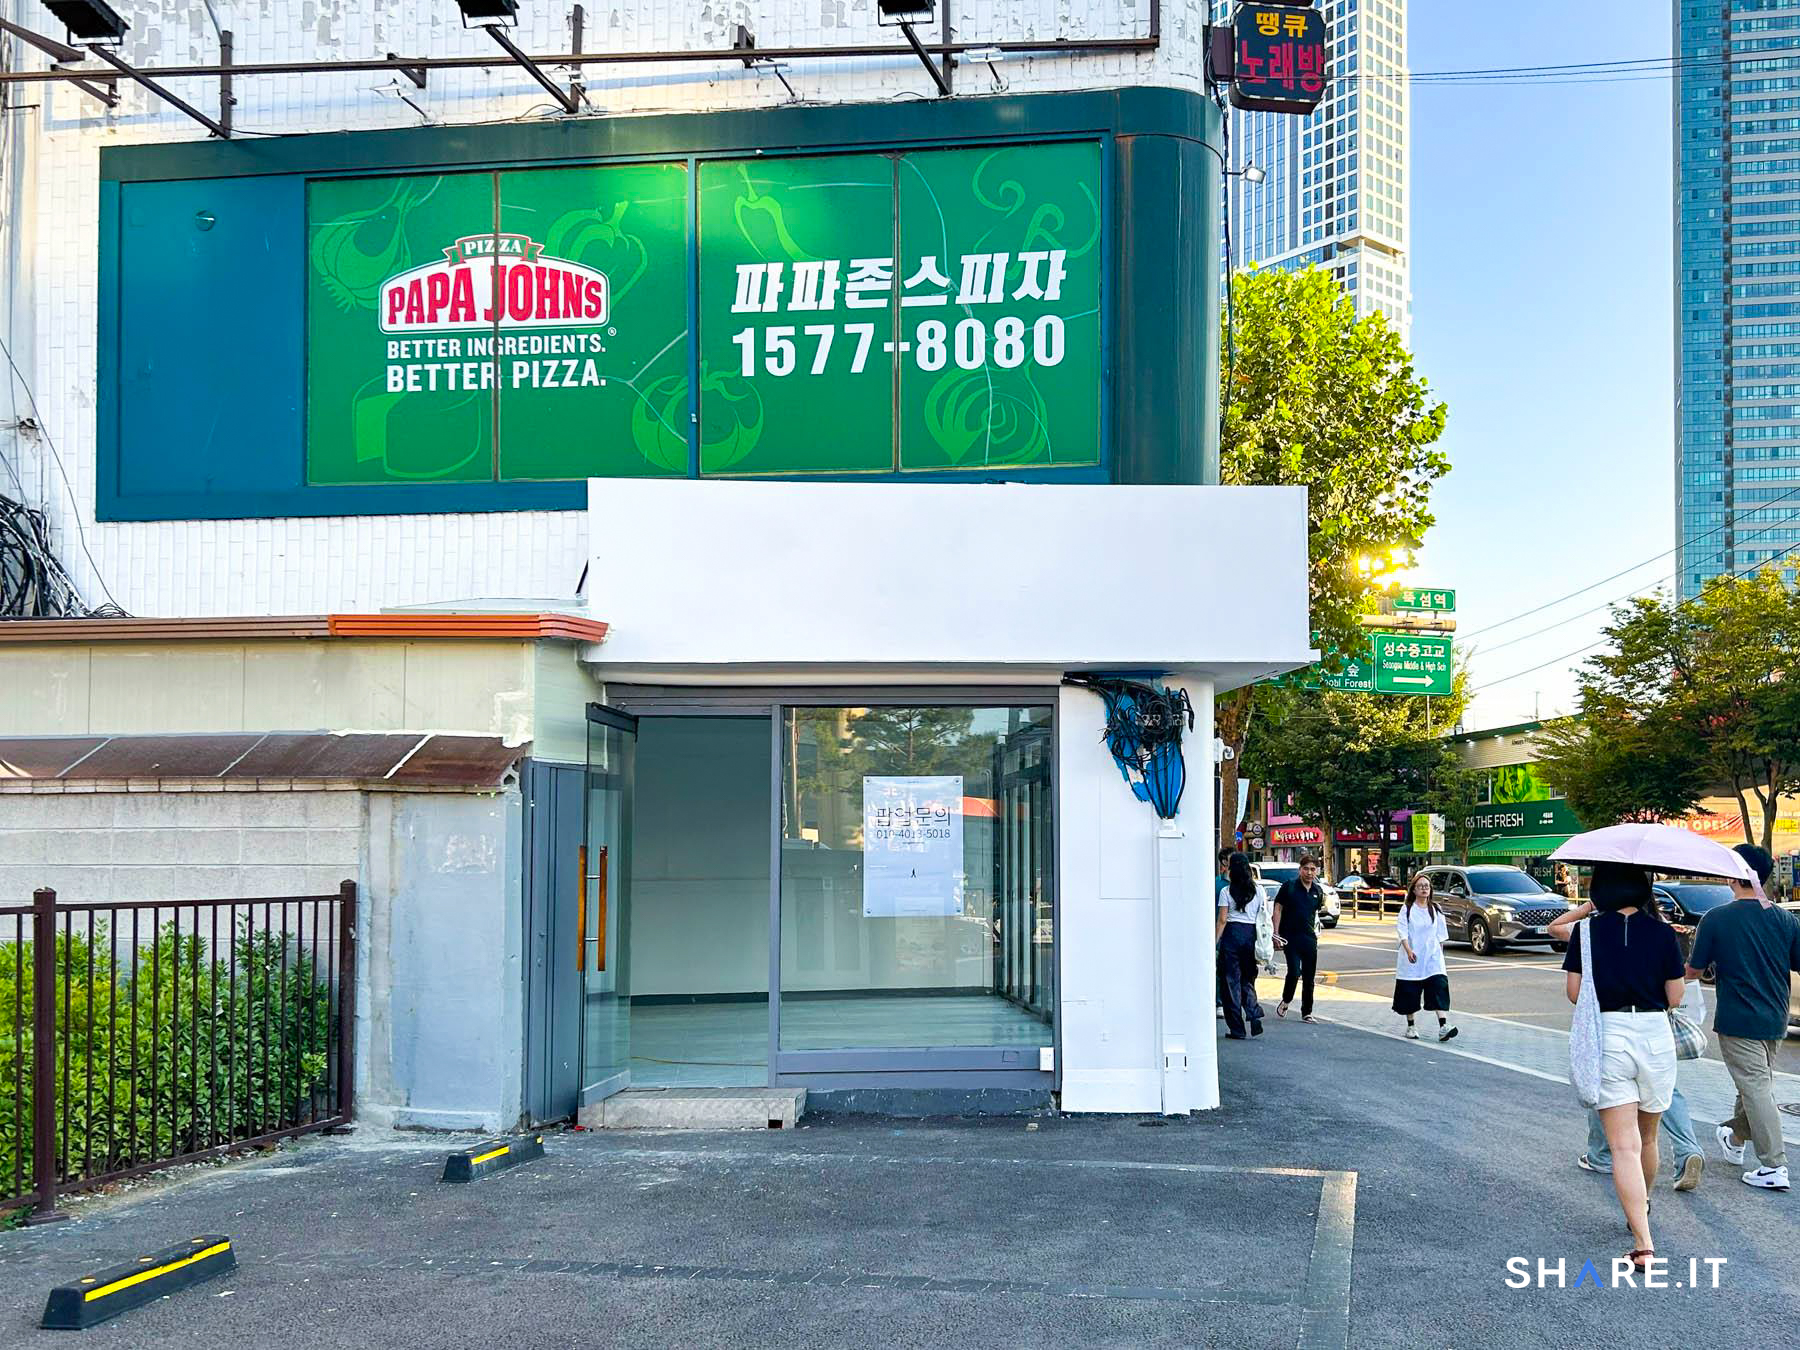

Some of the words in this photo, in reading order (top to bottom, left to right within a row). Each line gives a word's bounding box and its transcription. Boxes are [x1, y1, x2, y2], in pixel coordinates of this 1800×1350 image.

[1256, 12, 1308, 38] 땡큐
[1241, 40, 1325, 92] 노래방
[464, 238, 523, 255] PIZZA
[388, 267, 477, 325] PAPA
[484, 263, 602, 322] JOHN'S
[730, 249, 1067, 313] 파파존스피자
[387, 338, 461, 360] BETTER
[467, 333, 607, 356] INGREDIENTS.
[732, 314, 1066, 377] 1577-8080
[386, 361, 502, 393] BETTER
[512, 358, 607, 389] PIZZA.
[1383, 642, 1445, 658] 성수중고교
[1344, 678, 1372, 688] Forest
[876, 806, 950, 826] 팝업문의
[1476, 815, 1493, 829] THE
[1494, 812, 1524, 828] FRESH
